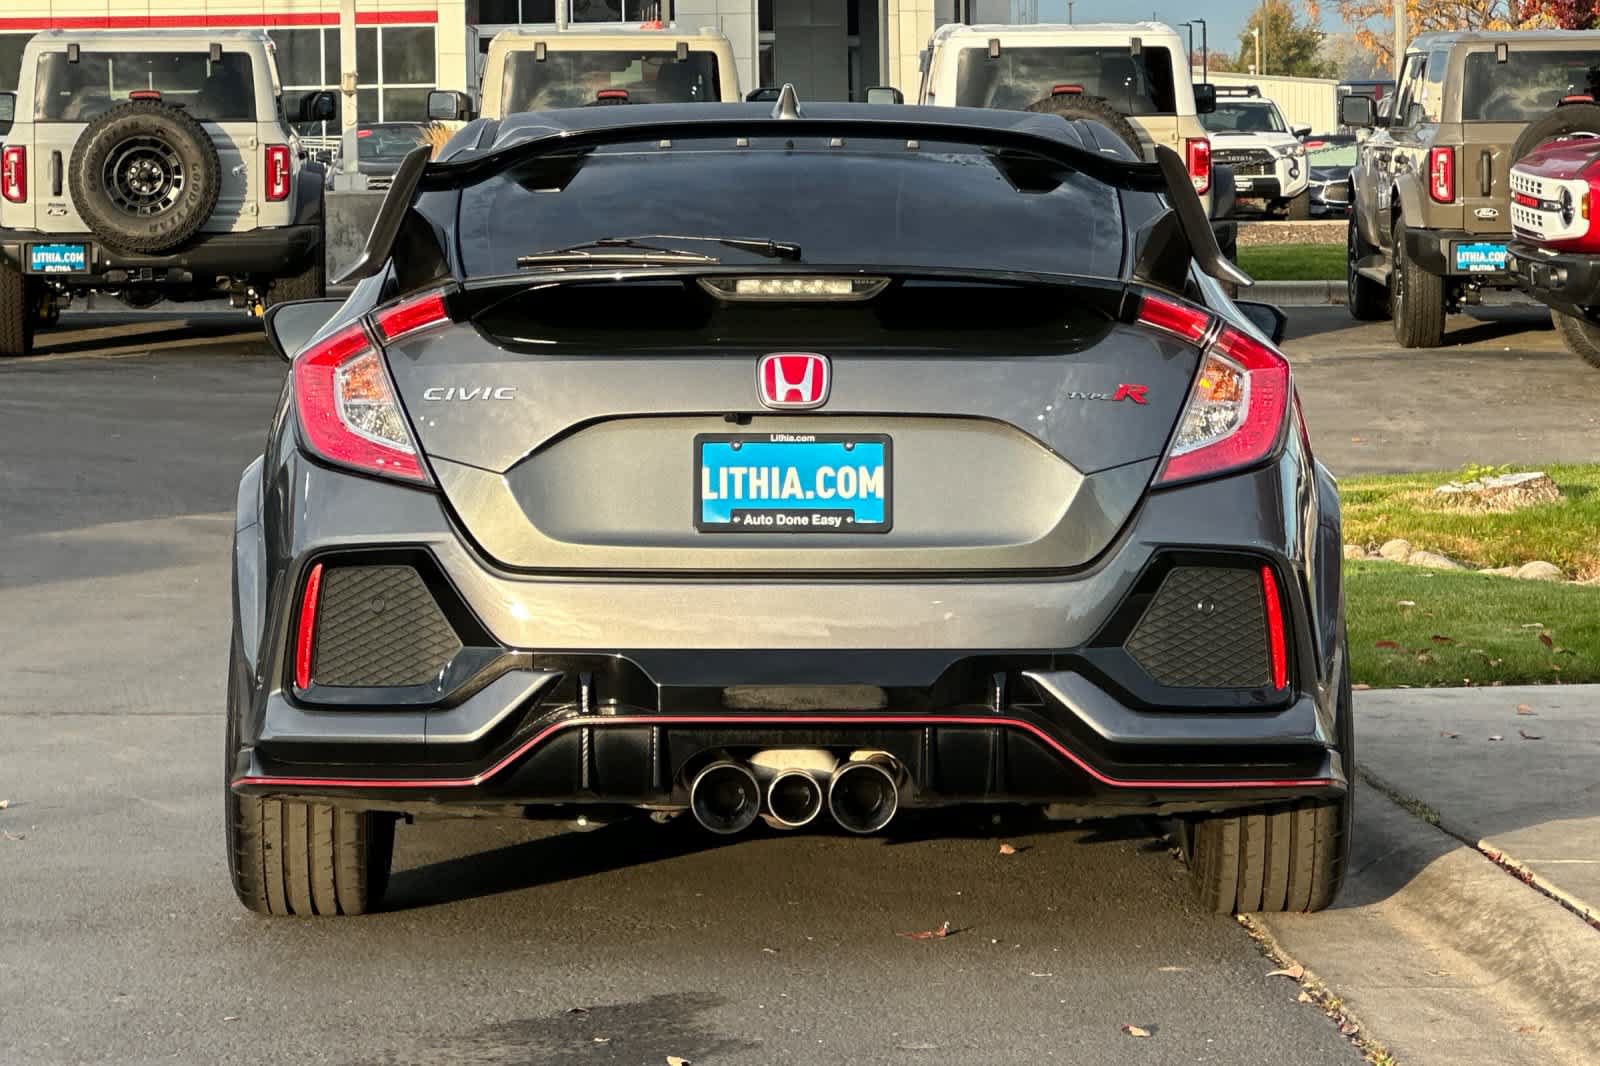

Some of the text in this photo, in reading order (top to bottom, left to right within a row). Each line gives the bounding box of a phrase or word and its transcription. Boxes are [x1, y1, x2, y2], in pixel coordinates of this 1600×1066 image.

[32, 252, 84, 263] LITHIA.COM
[423, 387, 517, 401] CIVIC
[1112, 383, 1149, 405] R
[770, 434, 815, 442] Lithia.com
[701, 465, 884, 500] LITHIA.COM
[743, 514, 842, 527] Auto Done Easy
